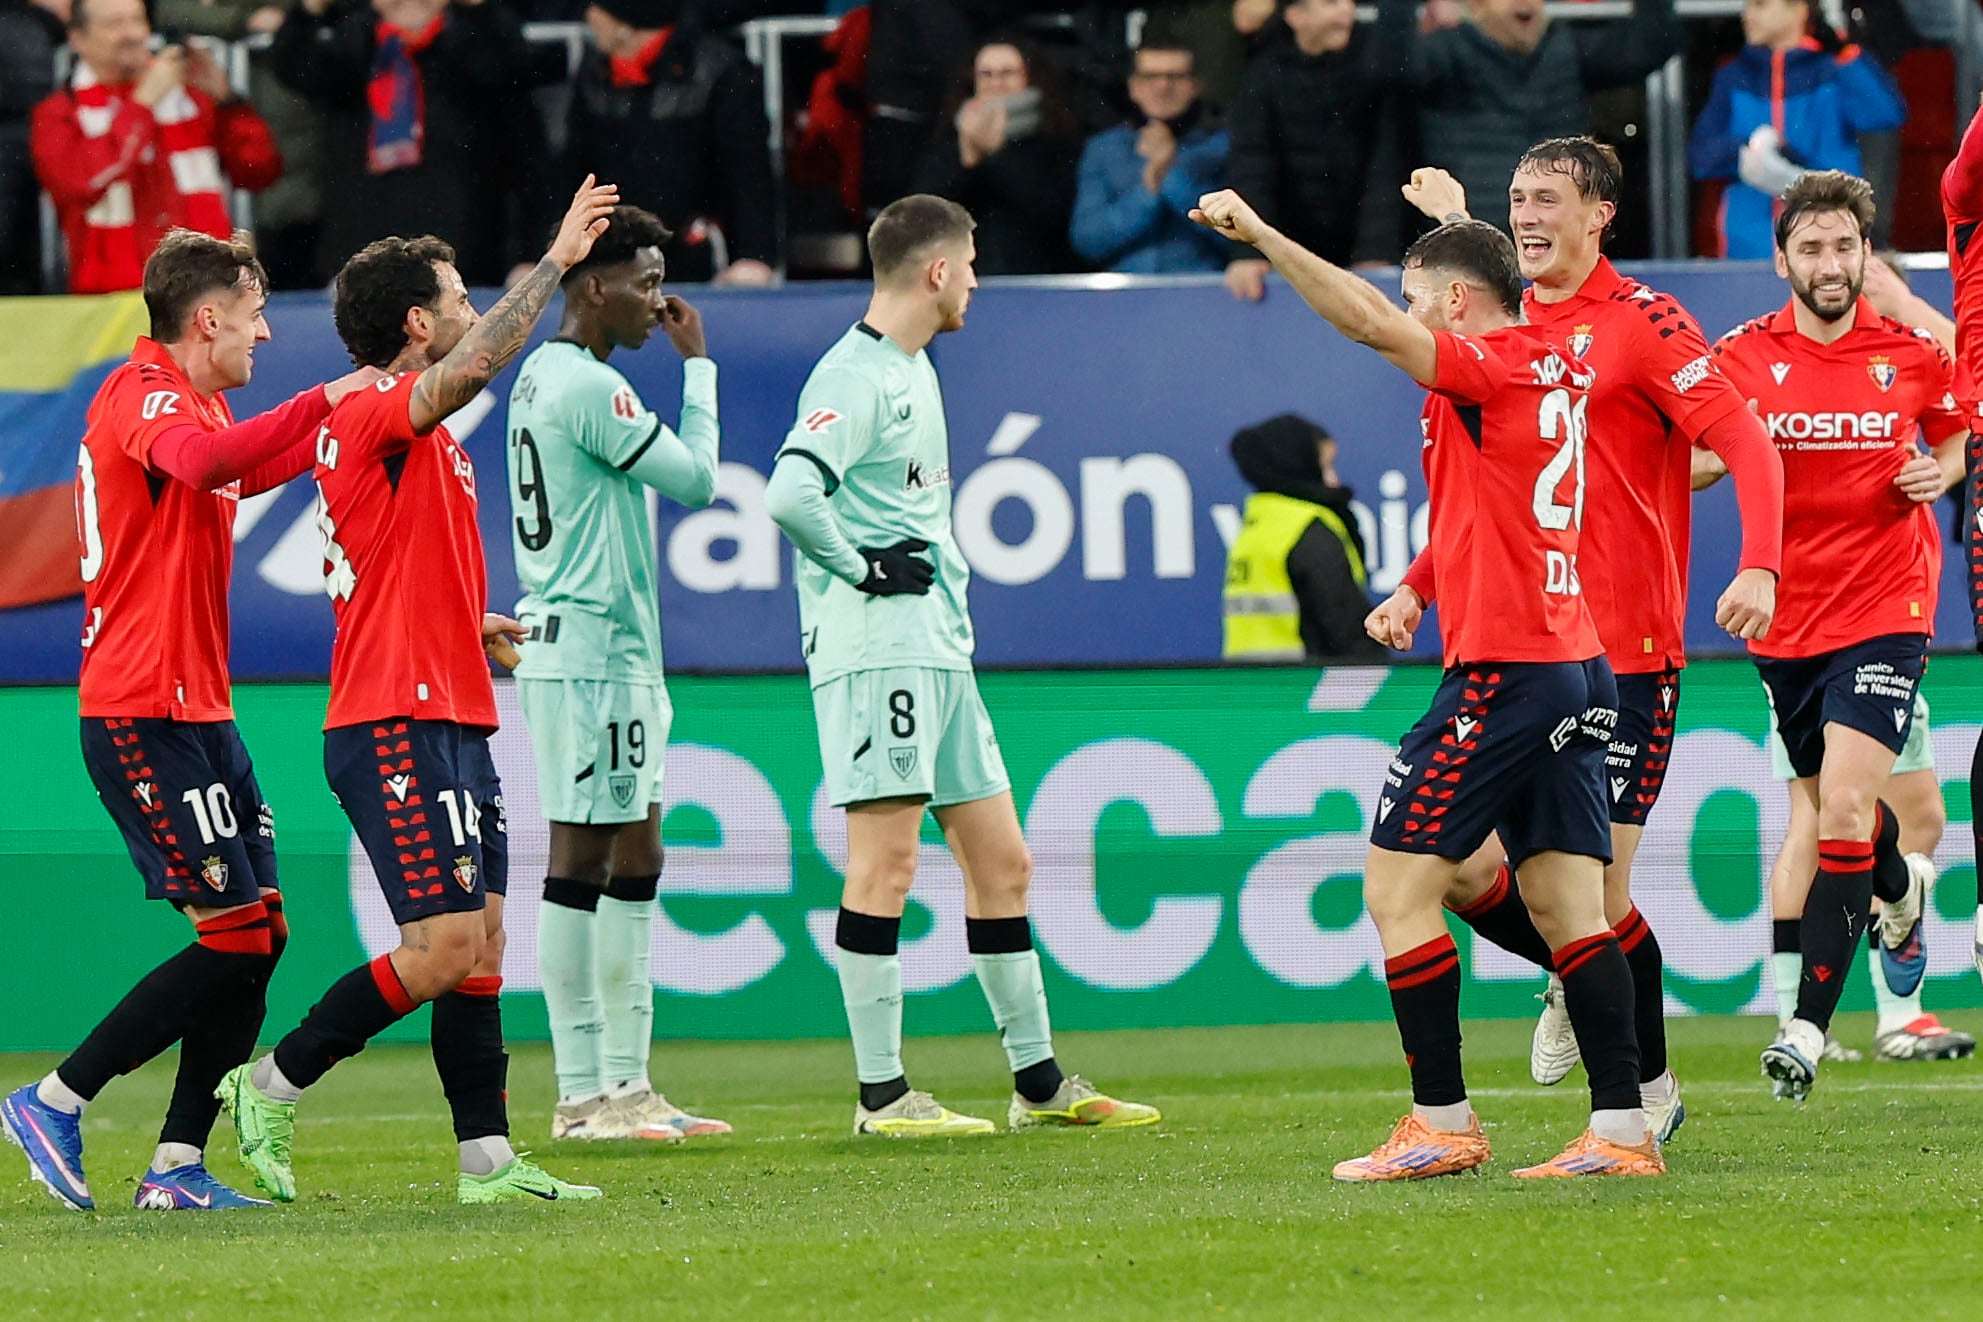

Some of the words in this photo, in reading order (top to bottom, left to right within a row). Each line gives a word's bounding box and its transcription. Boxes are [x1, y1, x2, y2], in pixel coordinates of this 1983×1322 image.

[1676, 366, 1710, 394] HOME
[1796, 439, 1859, 451] Climatización
[512, 427, 552, 551] 9
[1854, 682, 1868, 694] de
[1870, 683, 1911, 701] Navarra
[1855, 672, 1915, 690] Universidad
[889, 689, 915, 739] 8
[1581, 707, 1618, 728] YPTO
[607, 719, 645, 770] 19
[182, 782, 238, 845] 10
[437, 789, 482, 847] 14
